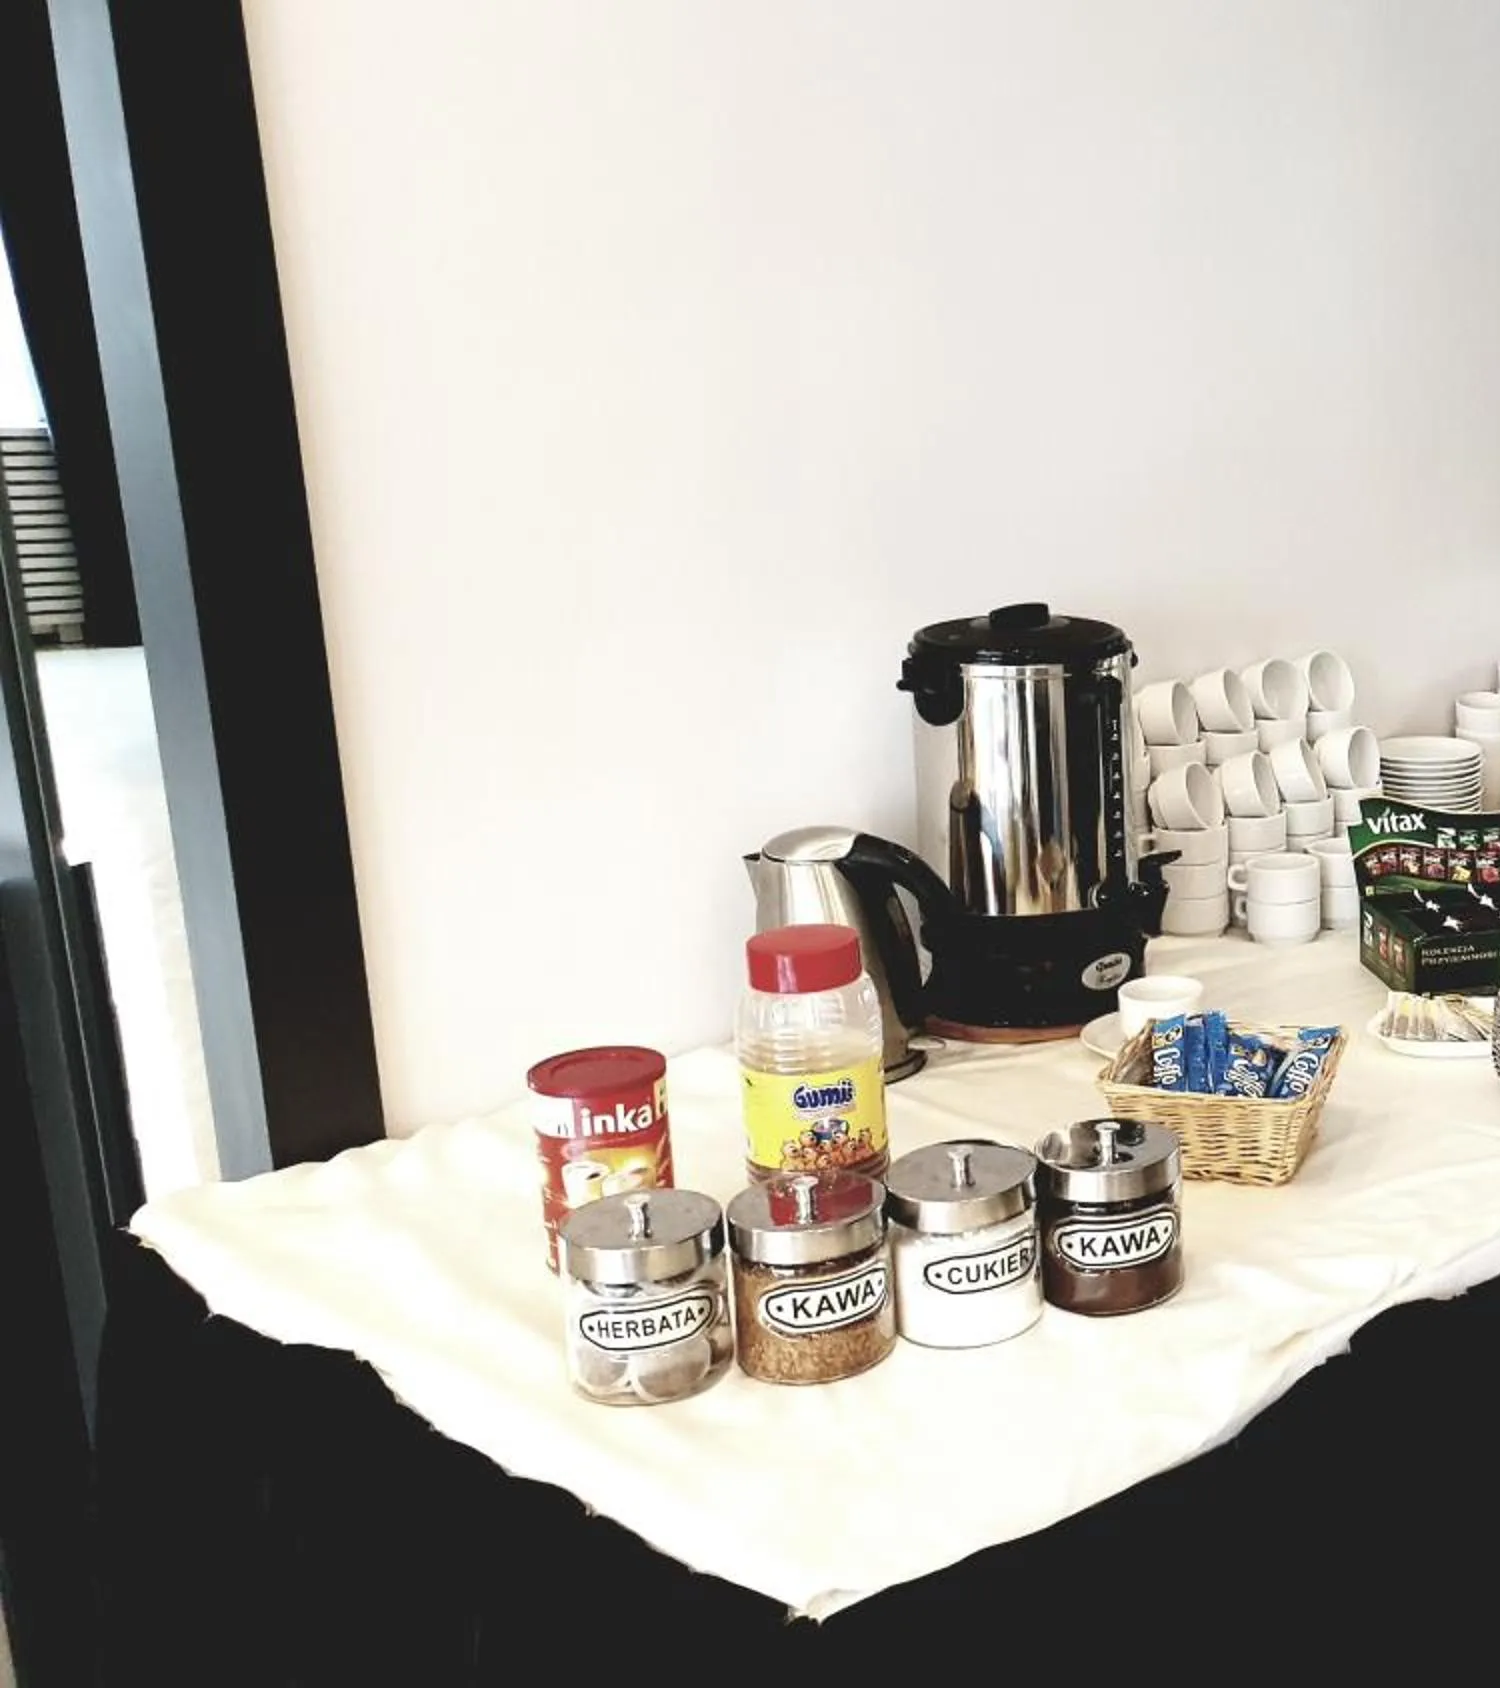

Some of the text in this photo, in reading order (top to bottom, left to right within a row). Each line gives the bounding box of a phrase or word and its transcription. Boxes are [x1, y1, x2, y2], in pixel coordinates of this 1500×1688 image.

[1079, 1225, 1161, 1258] KAWA
[947, 1247, 1031, 1286] CUKIER
[791, 1279, 877, 1321] KAWA
[596, 1307, 697, 1340] HERBATA
